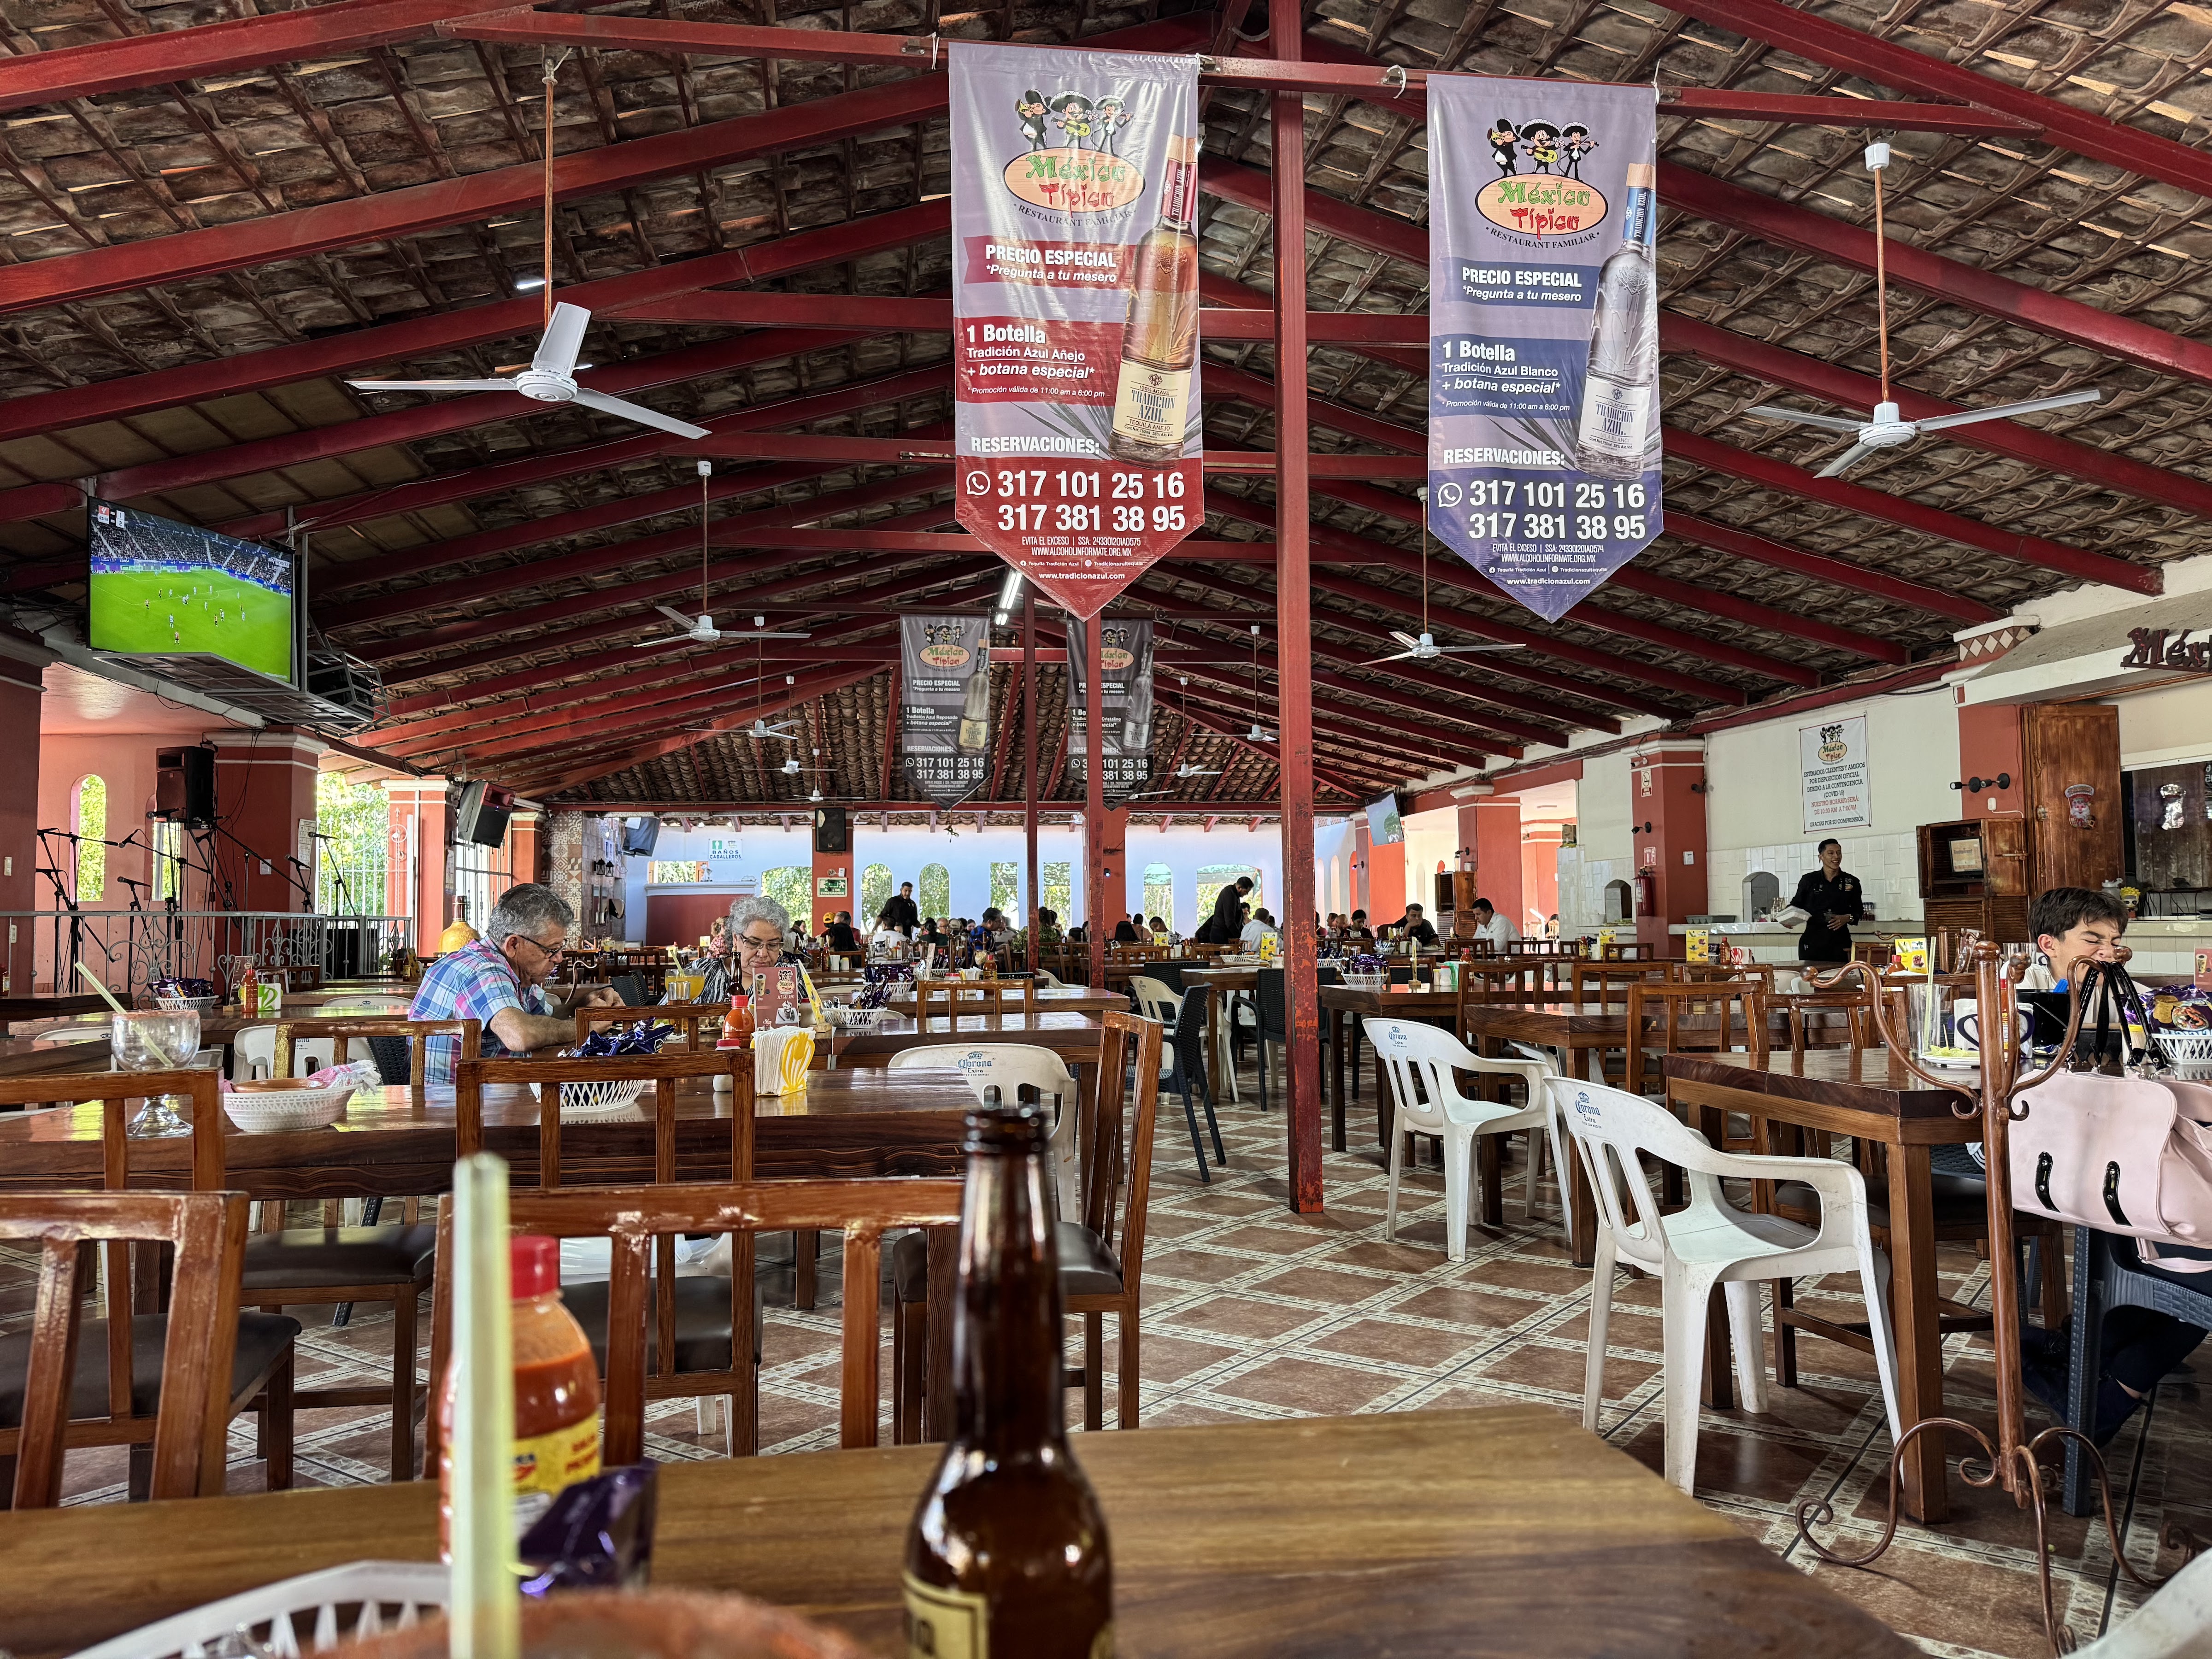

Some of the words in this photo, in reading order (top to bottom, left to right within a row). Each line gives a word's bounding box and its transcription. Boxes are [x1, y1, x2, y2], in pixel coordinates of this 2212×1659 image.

[1026, 155, 1125, 182] México
[1039, 183, 1114, 218] Típico
[1498, 181, 1590, 206] México
[1018, 205, 1082, 226] RESTAURANT
[1085, 211, 1130, 225] FAMILIAR
[1510, 207, 1579, 240] Típico
[1490, 228, 1550, 249] RESTAURANT
[1552, 232, 1596, 248] FAMILIAR
[986, 244, 1040, 264] PRECIO
[1045, 250, 1117, 267] ESPECIAL
[1058, 270, 1070, 281] tu
[1073, 272, 1116, 282] mesero
[1462, 266, 1511, 285] PRECIO
[1515, 271, 1582, 287] ESPECIAL
[1527, 289, 1538, 300] tu
[1541, 292, 1582, 301] mesero
[967, 326, 975, 343] 1
[983, 324, 1046, 345] Botella
[967, 347, 1020, 359] Tradición
[1023, 347, 1048, 359] Azul
[1052, 347, 1085, 362] Añejo
[1443, 342, 1451, 359] 1
[1459, 341, 1515, 362] Botella
[979, 363, 1028, 376] botana
[1442, 363, 1492, 374] Tradición
[1494, 365, 1517, 376] Azul
[1521, 366, 1558, 377] Blanco
[971, 386, 1006, 395] Promoción
[1009, 386, 1028, 394] válida
[1041, 387, 1059, 395] 11:00
[1454, 377, 1498, 392] botana
[1132, 390, 1175, 409] TRADICION
[1596, 403, 1634, 423] TRADICION
[1130, 419, 1151, 429] TEQUILA
[971, 436, 1100, 454] RESERVACIONES:
[1444, 448, 1565, 466] RESERVACIONES:
[998, 470, 1047, 497] 317
[1056, 471, 1100, 498] 101
[1112, 472, 1144, 499] 25
[1153, 472, 1184, 499] 16
[1470, 480, 1515, 507] 317
[1524, 482, 1565, 507] 101
[1576, 483, 1605, 508] 25
[1613, 484, 1645, 509] 16
[998, 505, 1047, 531] 317
[1056, 505, 1100, 531] 381
[1112, 506, 1145, 532] 38
[1153, 505, 1185, 531] 95
[1469, 512, 1516, 539] 317
[1524, 514, 1566, 539] 381
[1577, 515, 1607, 540] 38
[1614, 515, 1646, 540] 95
[1022, 536, 1037, 545] EVITA
[1039, 536, 1046, 545] EL
[1047, 536, 1069, 545] EXCESO
[1078, 537, 1091, 546] SSA:
[1493, 543, 1508, 552] EVITA
[1510, 544, 1516, 552] EL
[1517, 544, 1537, 553] EXCESO
[1545, 544, 1557, 553] SSA:
[1031, 547, 1132, 556] WWW.ALCOHOLINFORMATE.ORG.MX
[1501, 553, 1596, 563] WWW.ALCOHOLINFORMATE.ORG.MX
[2123, 627, 2212, 667] Méx
[916, 758, 934, 767] 317
[937, 758, 953, 767] 101
[958, 758, 970, 767] 25
[972, 758, 984, 767] 16
[1103, 759, 1118, 768] 101
[1122, 759, 1134, 768] 25
[1136, 759, 1148, 768] 16
[916, 770, 934, 779] 317
[937, 770, 954, 779] 381
[958, 770, 970, 779] 38
[972, 770, 984, 779] 95
[1103, 771, 1118, 780] 381
[1122, 771, 1134, 780] 38
[1136, 771, 1148, 780] 95
[1804, 769, 1825, 777] ESTIMADOS
[1825, 765, 1844, 774] CLIENTES
[1831, 779, 1863, 788] CONTINGENCIA
[1388, 1031, 1407, 1041] Corona
[958, 1059, 992, 1069] Corona
[1575, 1100, 1601, 1116] Corona
